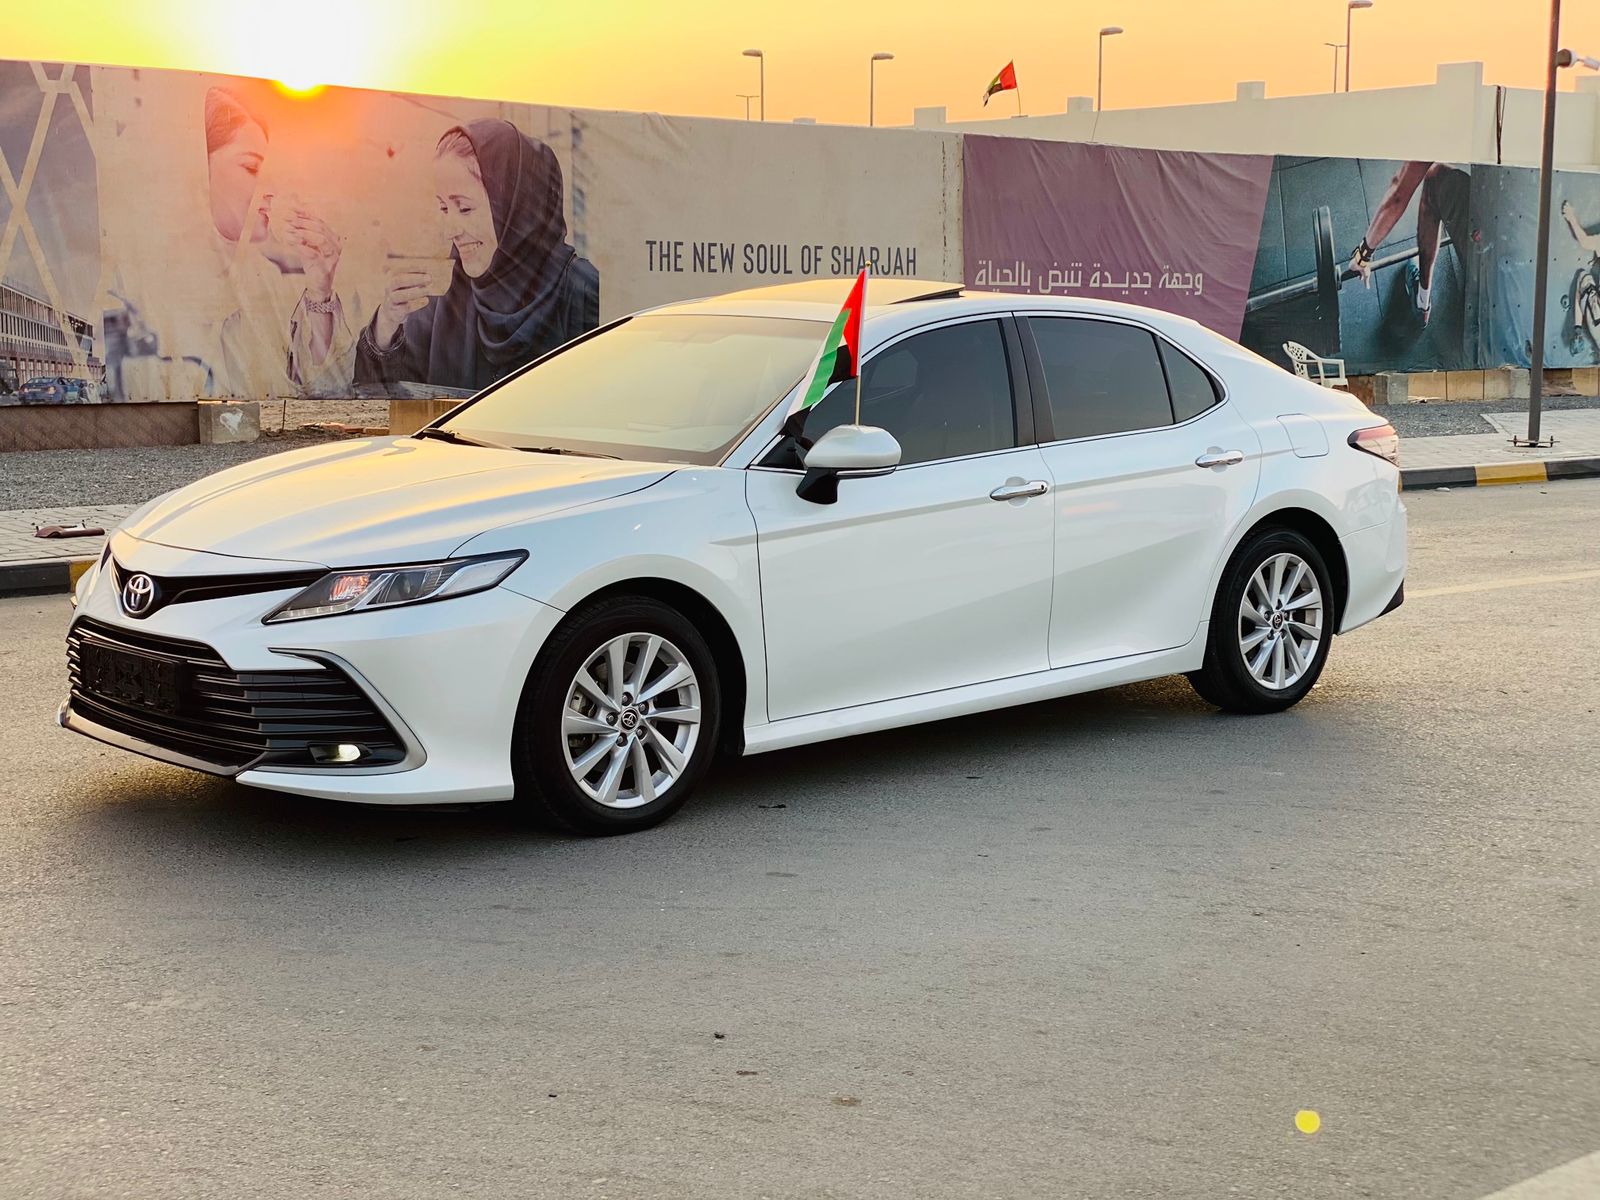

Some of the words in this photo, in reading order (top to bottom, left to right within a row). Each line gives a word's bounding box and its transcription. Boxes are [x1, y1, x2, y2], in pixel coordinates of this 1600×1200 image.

[645, 240, 684, 272] THE
[693, 242, 735, 273] NEW
[743, 243, 793, 275] SOUL
[800, 245, 824, 275] OF
[831, 245, 917, 276] SHARJAH
[974, 260, 1031, 293] بالحياة
[1038, 262, 1082, 294] تنبض
[1089, 263, 1152, 295] جديدة
[1158, 265, 1203, 296] وجهة
